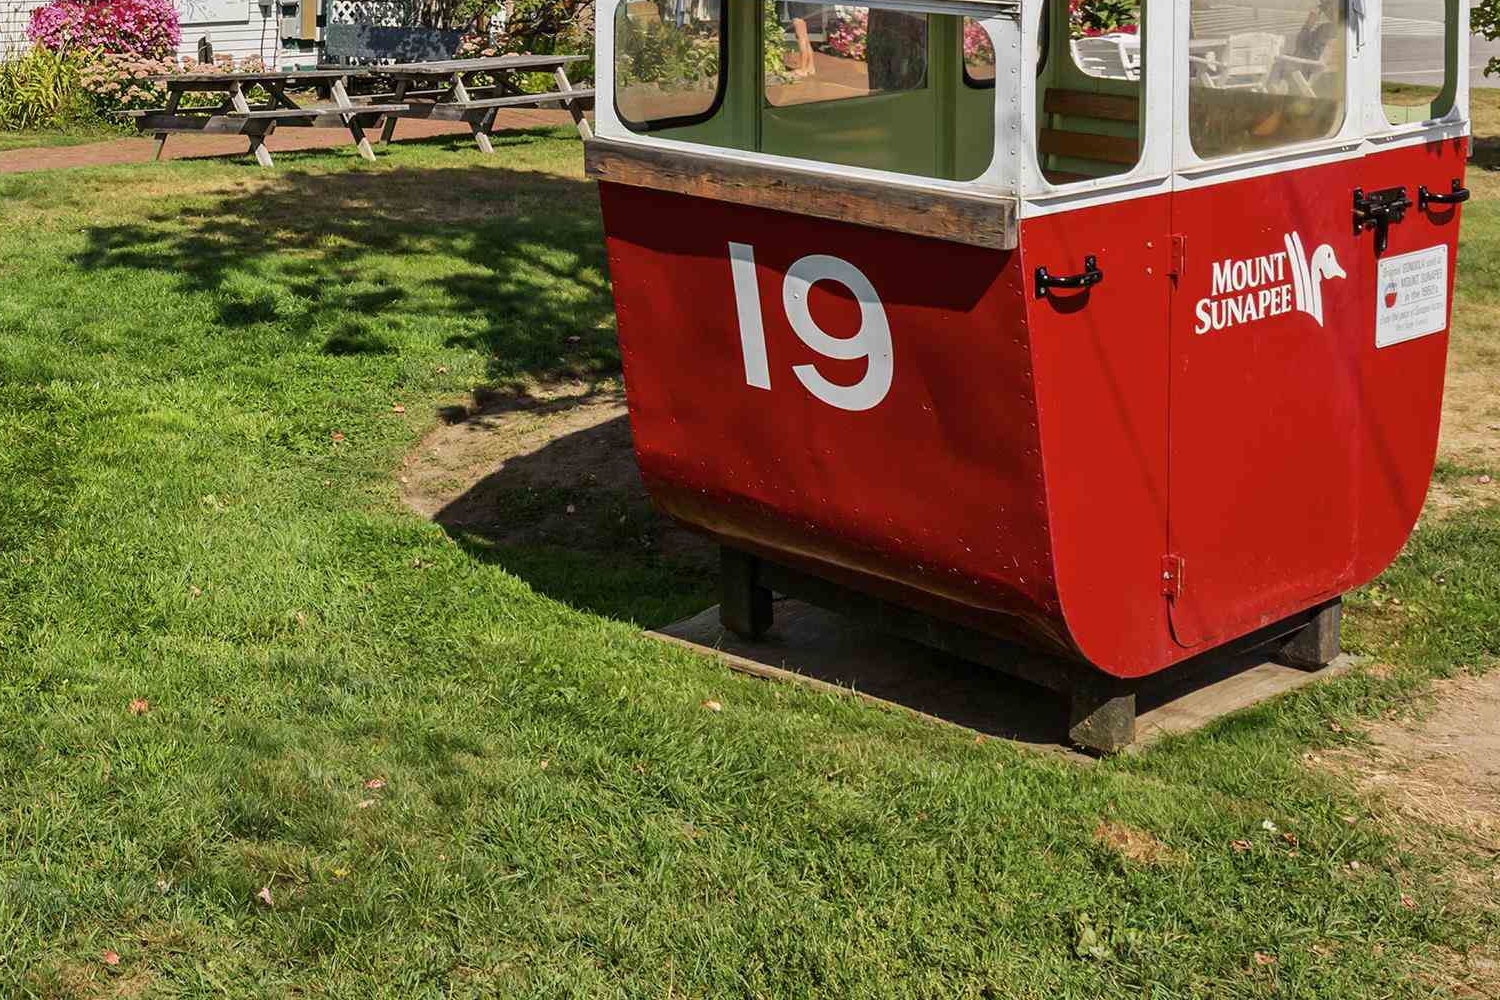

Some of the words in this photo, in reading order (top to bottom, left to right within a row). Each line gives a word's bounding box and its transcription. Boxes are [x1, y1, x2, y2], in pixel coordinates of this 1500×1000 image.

[1211, 251, 1287, 297] MOUNT
[726, 241, 895, 412] 19
[1194, 283, 1293, 336] SUNAPEE
